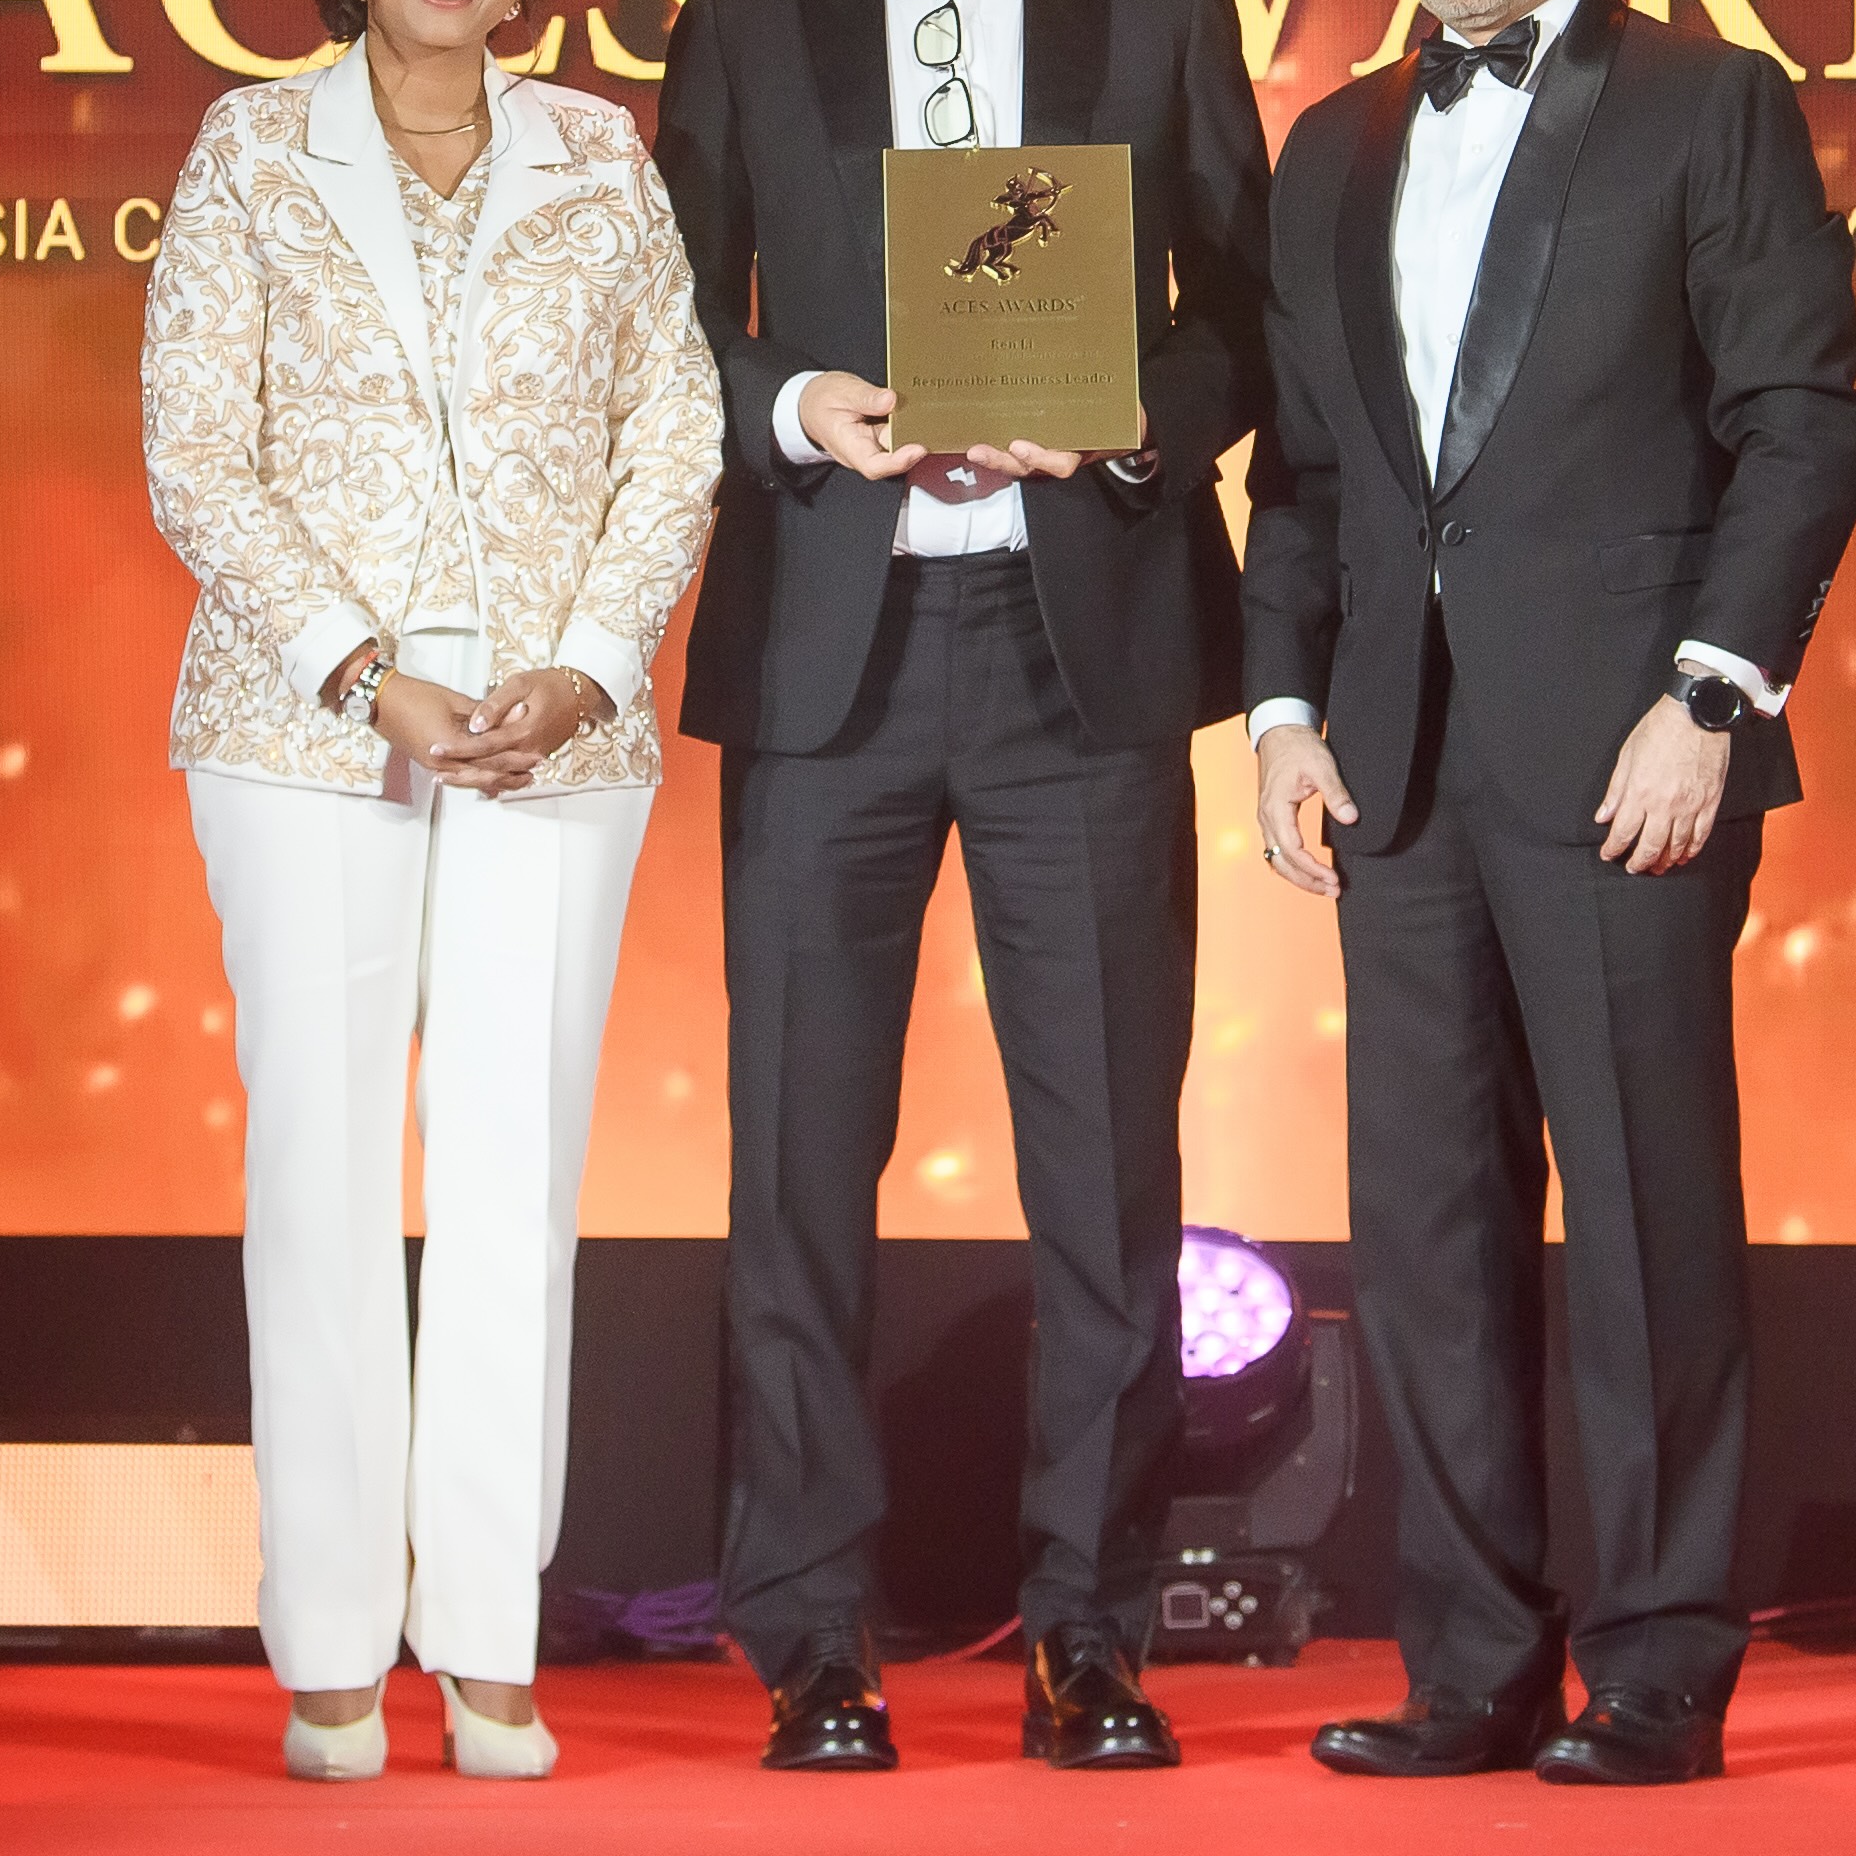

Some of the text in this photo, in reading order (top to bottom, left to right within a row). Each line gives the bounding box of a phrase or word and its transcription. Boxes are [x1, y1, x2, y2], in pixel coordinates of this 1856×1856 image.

[940, 297, 1077, 314] ACES AWARDS
[1000, 374, 1061, 386] Business
[1065, 372, 1114, 385] Leader
